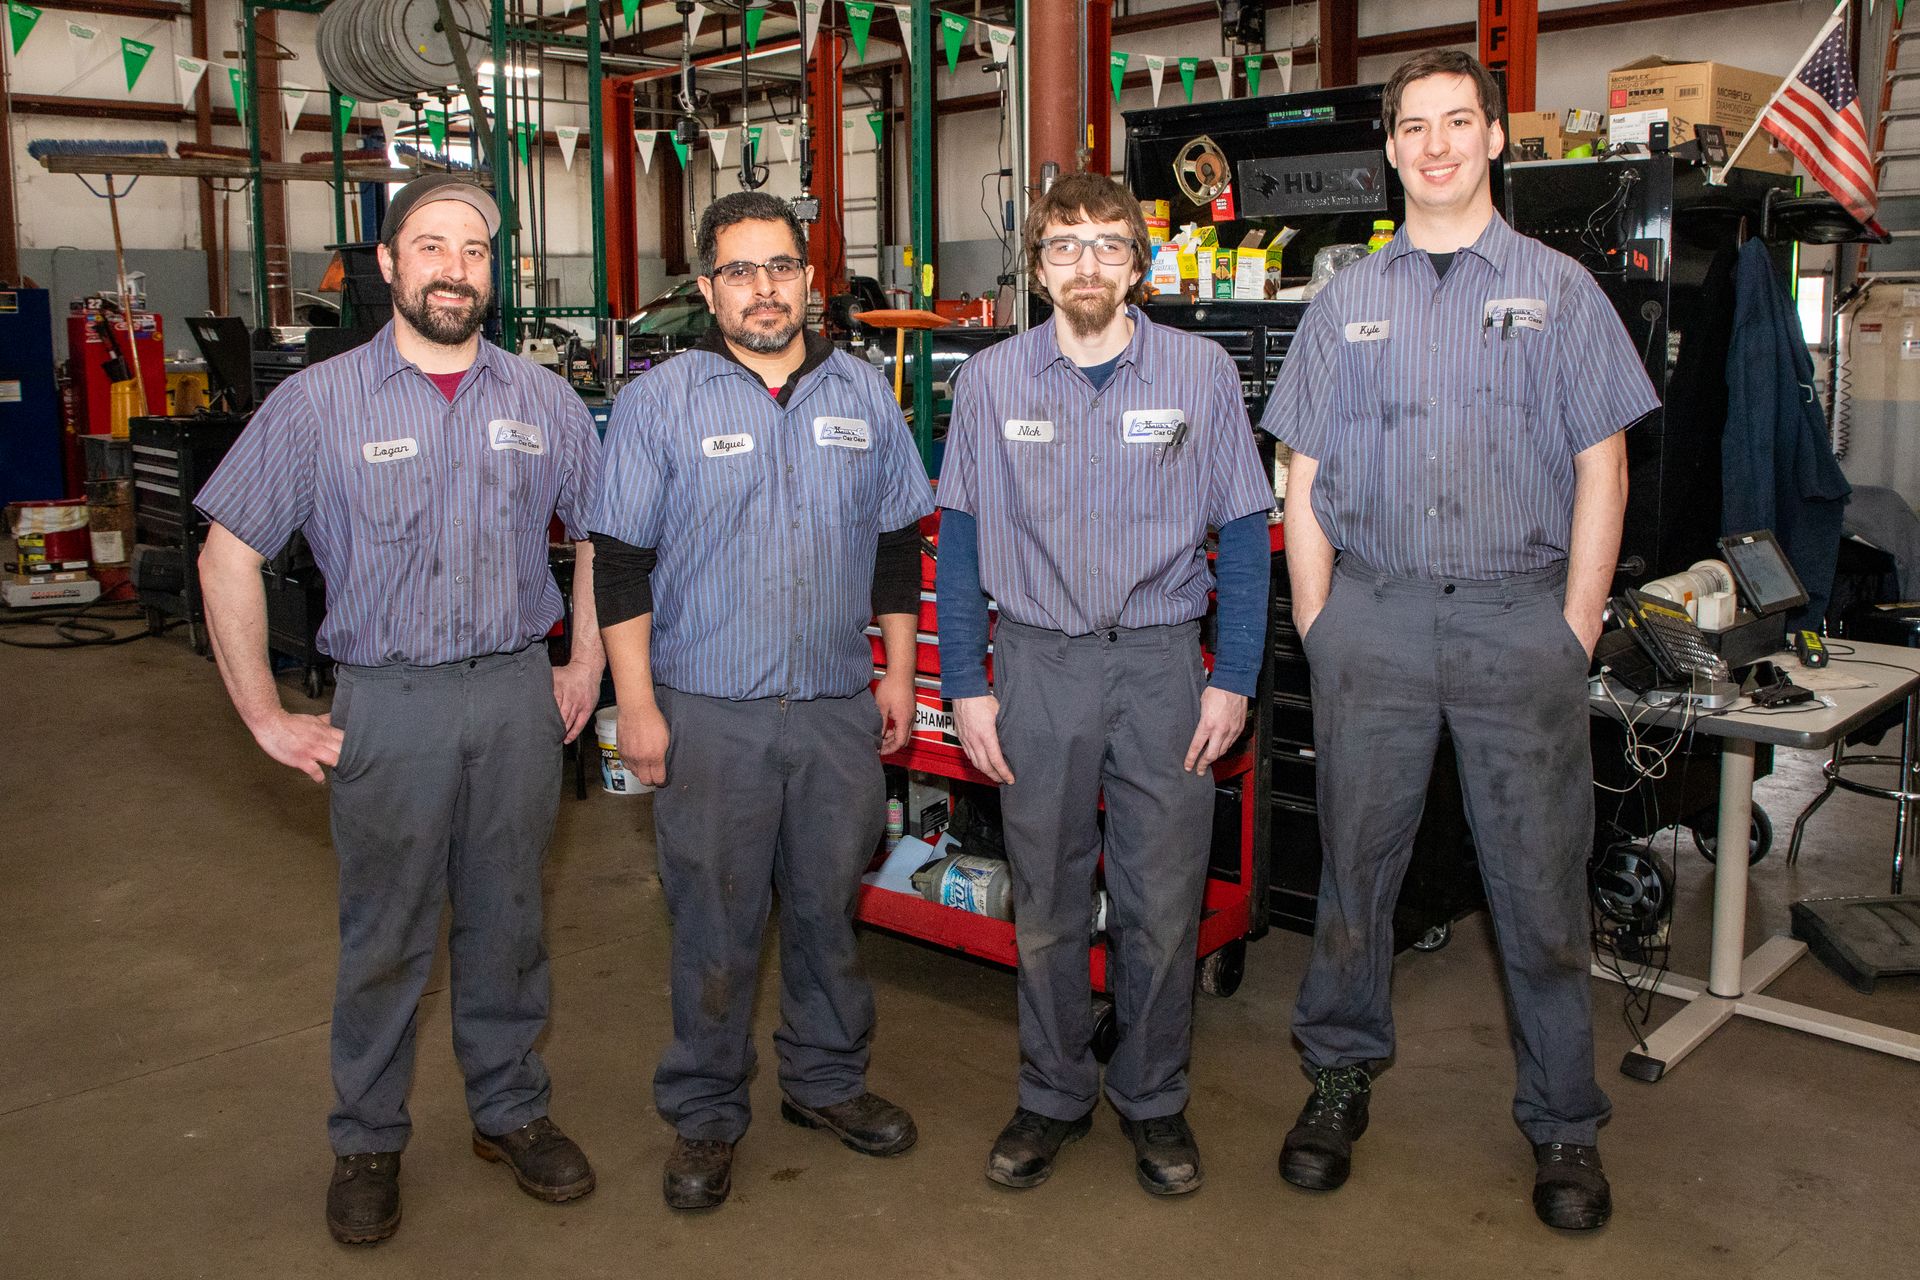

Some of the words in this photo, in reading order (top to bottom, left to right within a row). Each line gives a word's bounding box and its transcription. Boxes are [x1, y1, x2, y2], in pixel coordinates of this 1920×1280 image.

[1284, 167, 1380, 195] HUSKY
[1359, 325, 1380, 335] Kyle
[1017, 425, 1042, 437] Nick
[372, 444, 409, 459] Logan
[712, 437, 746, 453] Miguel
[914, 709, 956, 731] CHAMPI
[601, 749, 613, 758] 200
